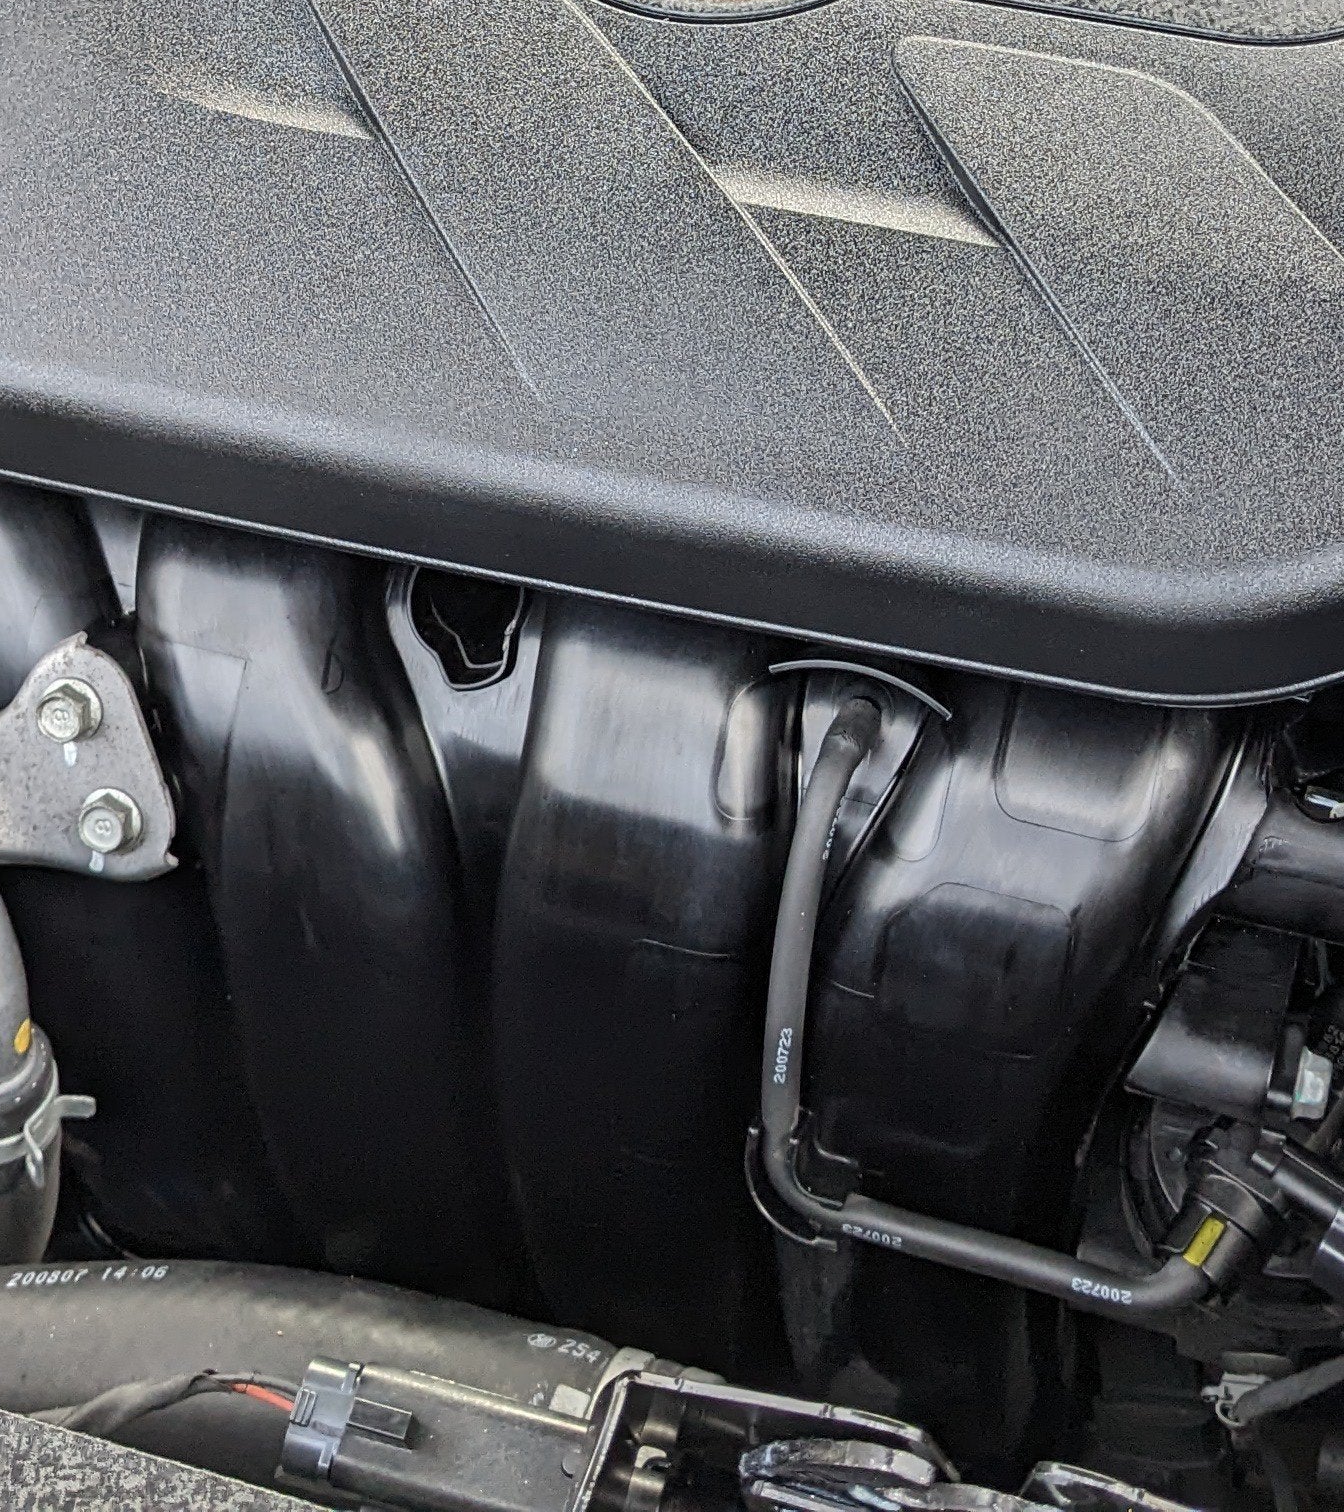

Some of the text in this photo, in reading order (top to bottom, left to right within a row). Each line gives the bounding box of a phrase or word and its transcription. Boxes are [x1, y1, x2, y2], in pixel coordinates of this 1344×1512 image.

[773, 1027, 793, 1085] 200723
[6, 1268, 90, 1288] 200807
[101, 1264, 170, 1282] 14:06
[1071, 1276, 1133, 1305] 200723
